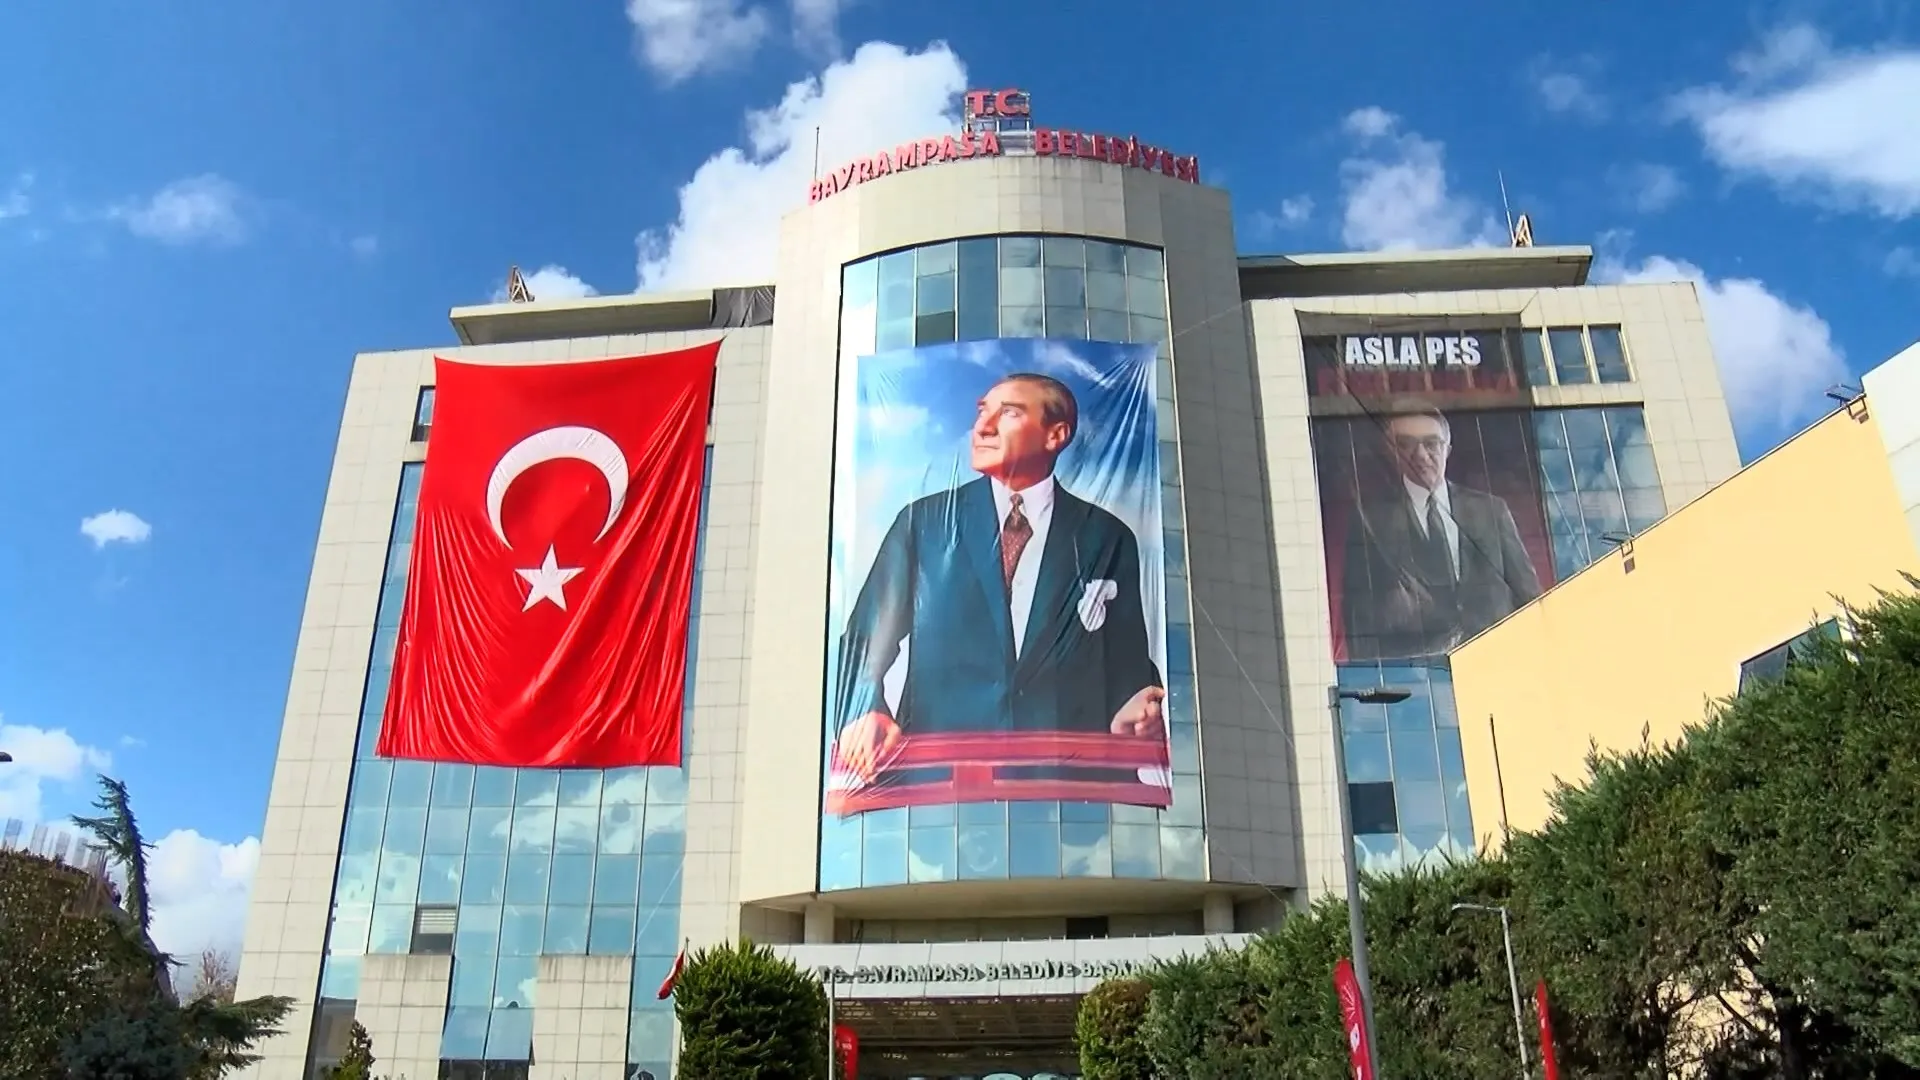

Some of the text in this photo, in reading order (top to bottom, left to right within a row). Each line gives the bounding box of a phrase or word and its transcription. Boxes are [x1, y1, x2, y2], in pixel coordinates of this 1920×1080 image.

[967, 88, 1030, 117] T.C.
[1344, 336, 1482, 367] ASLA PES
